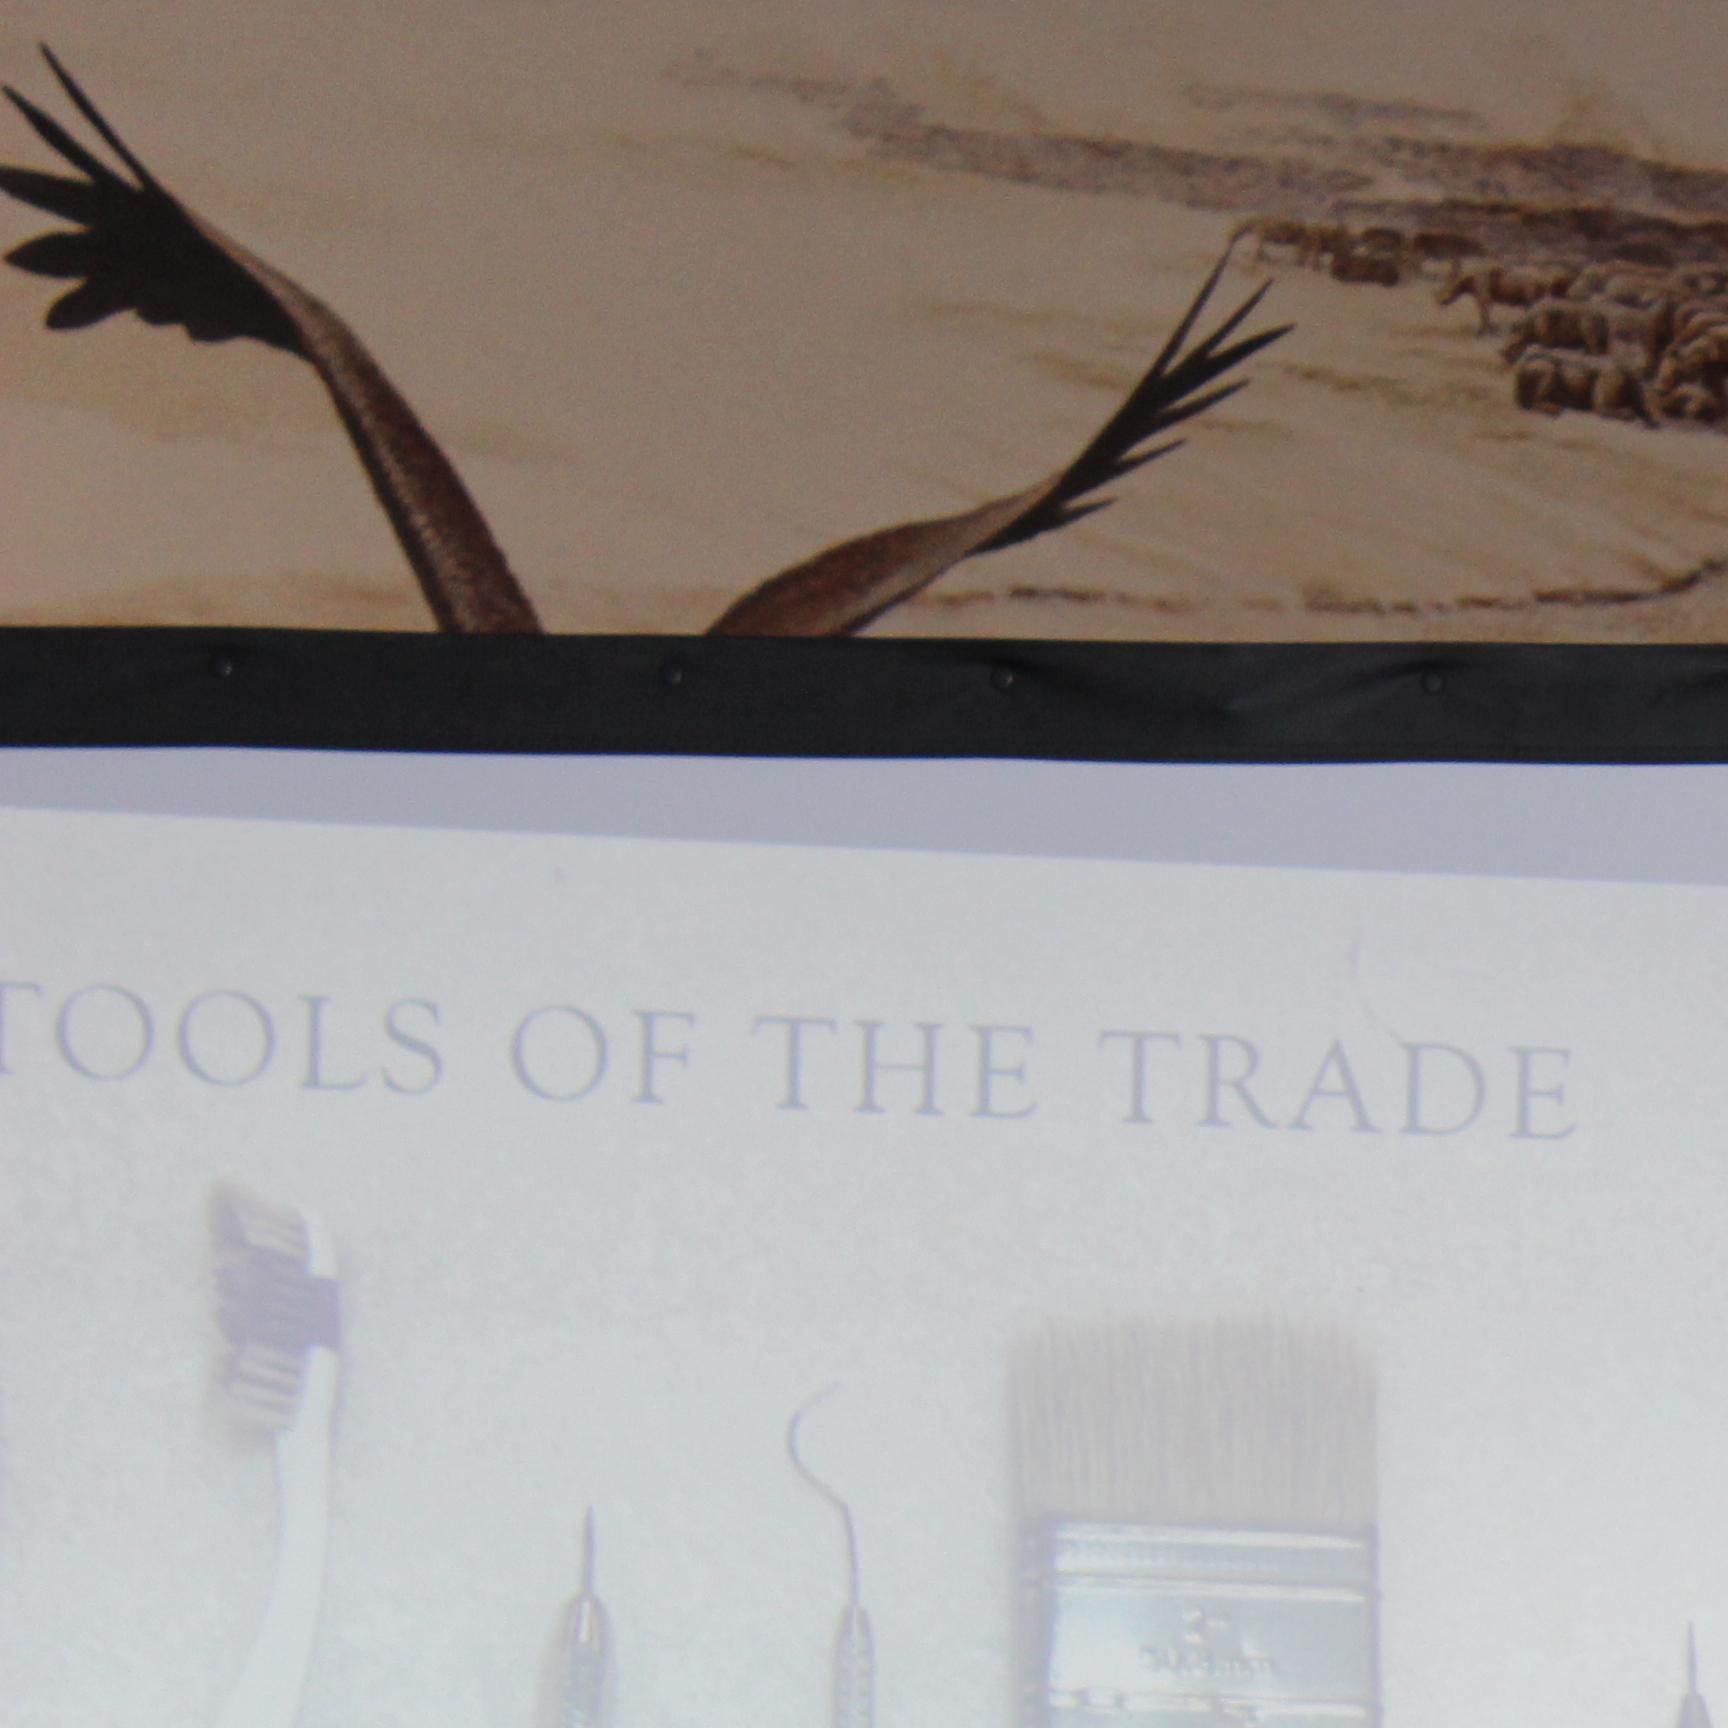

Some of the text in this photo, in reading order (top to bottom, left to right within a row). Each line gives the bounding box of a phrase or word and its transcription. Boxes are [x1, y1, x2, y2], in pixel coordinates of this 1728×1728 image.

[511, 1004, 696, 1105] OF
[752, 1014, 1038, 1120] THE
[1100, 1030, 1577, 1141] TRADE
